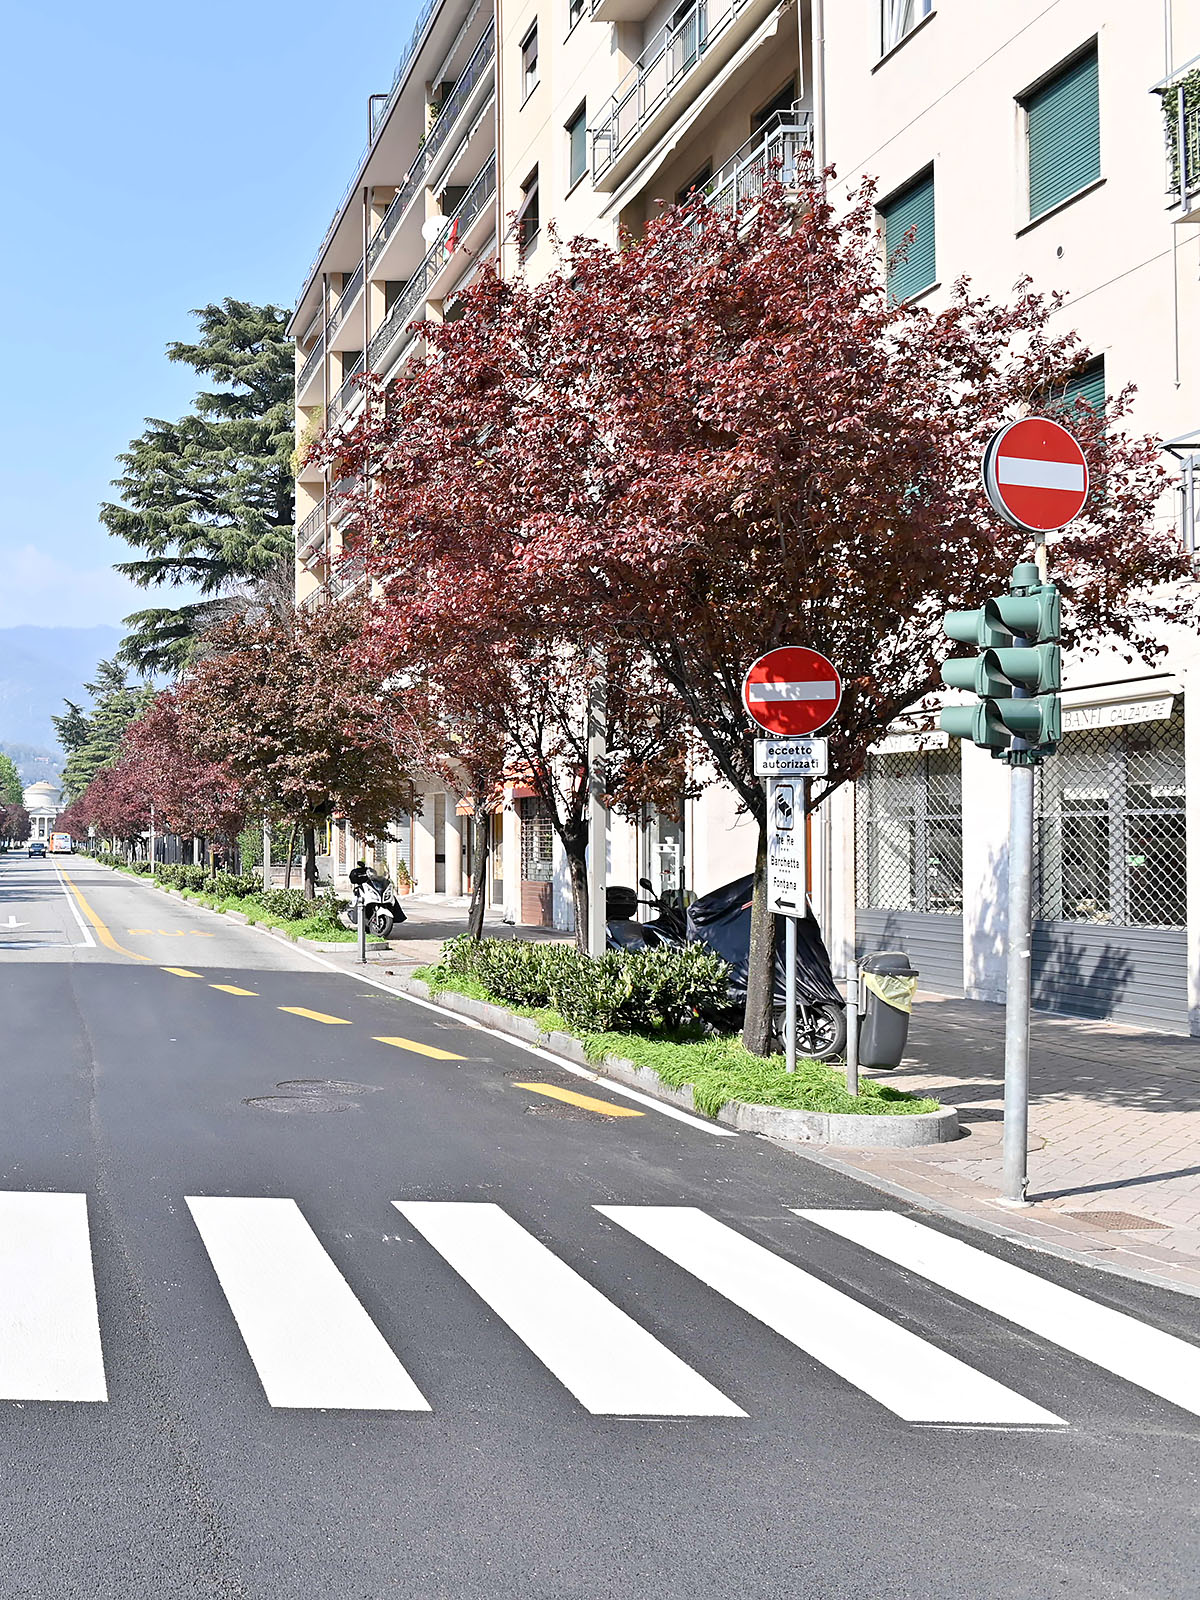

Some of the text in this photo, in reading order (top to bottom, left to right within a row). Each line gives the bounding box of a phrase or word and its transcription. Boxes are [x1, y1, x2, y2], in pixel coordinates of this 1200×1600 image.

[1064, 702, 1166, 728] BANFI CALZATURE
[768, 745, 813, 755] eccetto
[762, 758, 819, 769] autorizzati
[775, 833, 794, 846] Tre Re
[770, 855, 800, 869] Barchetta
[773, 876, 797, 891] Fontana
